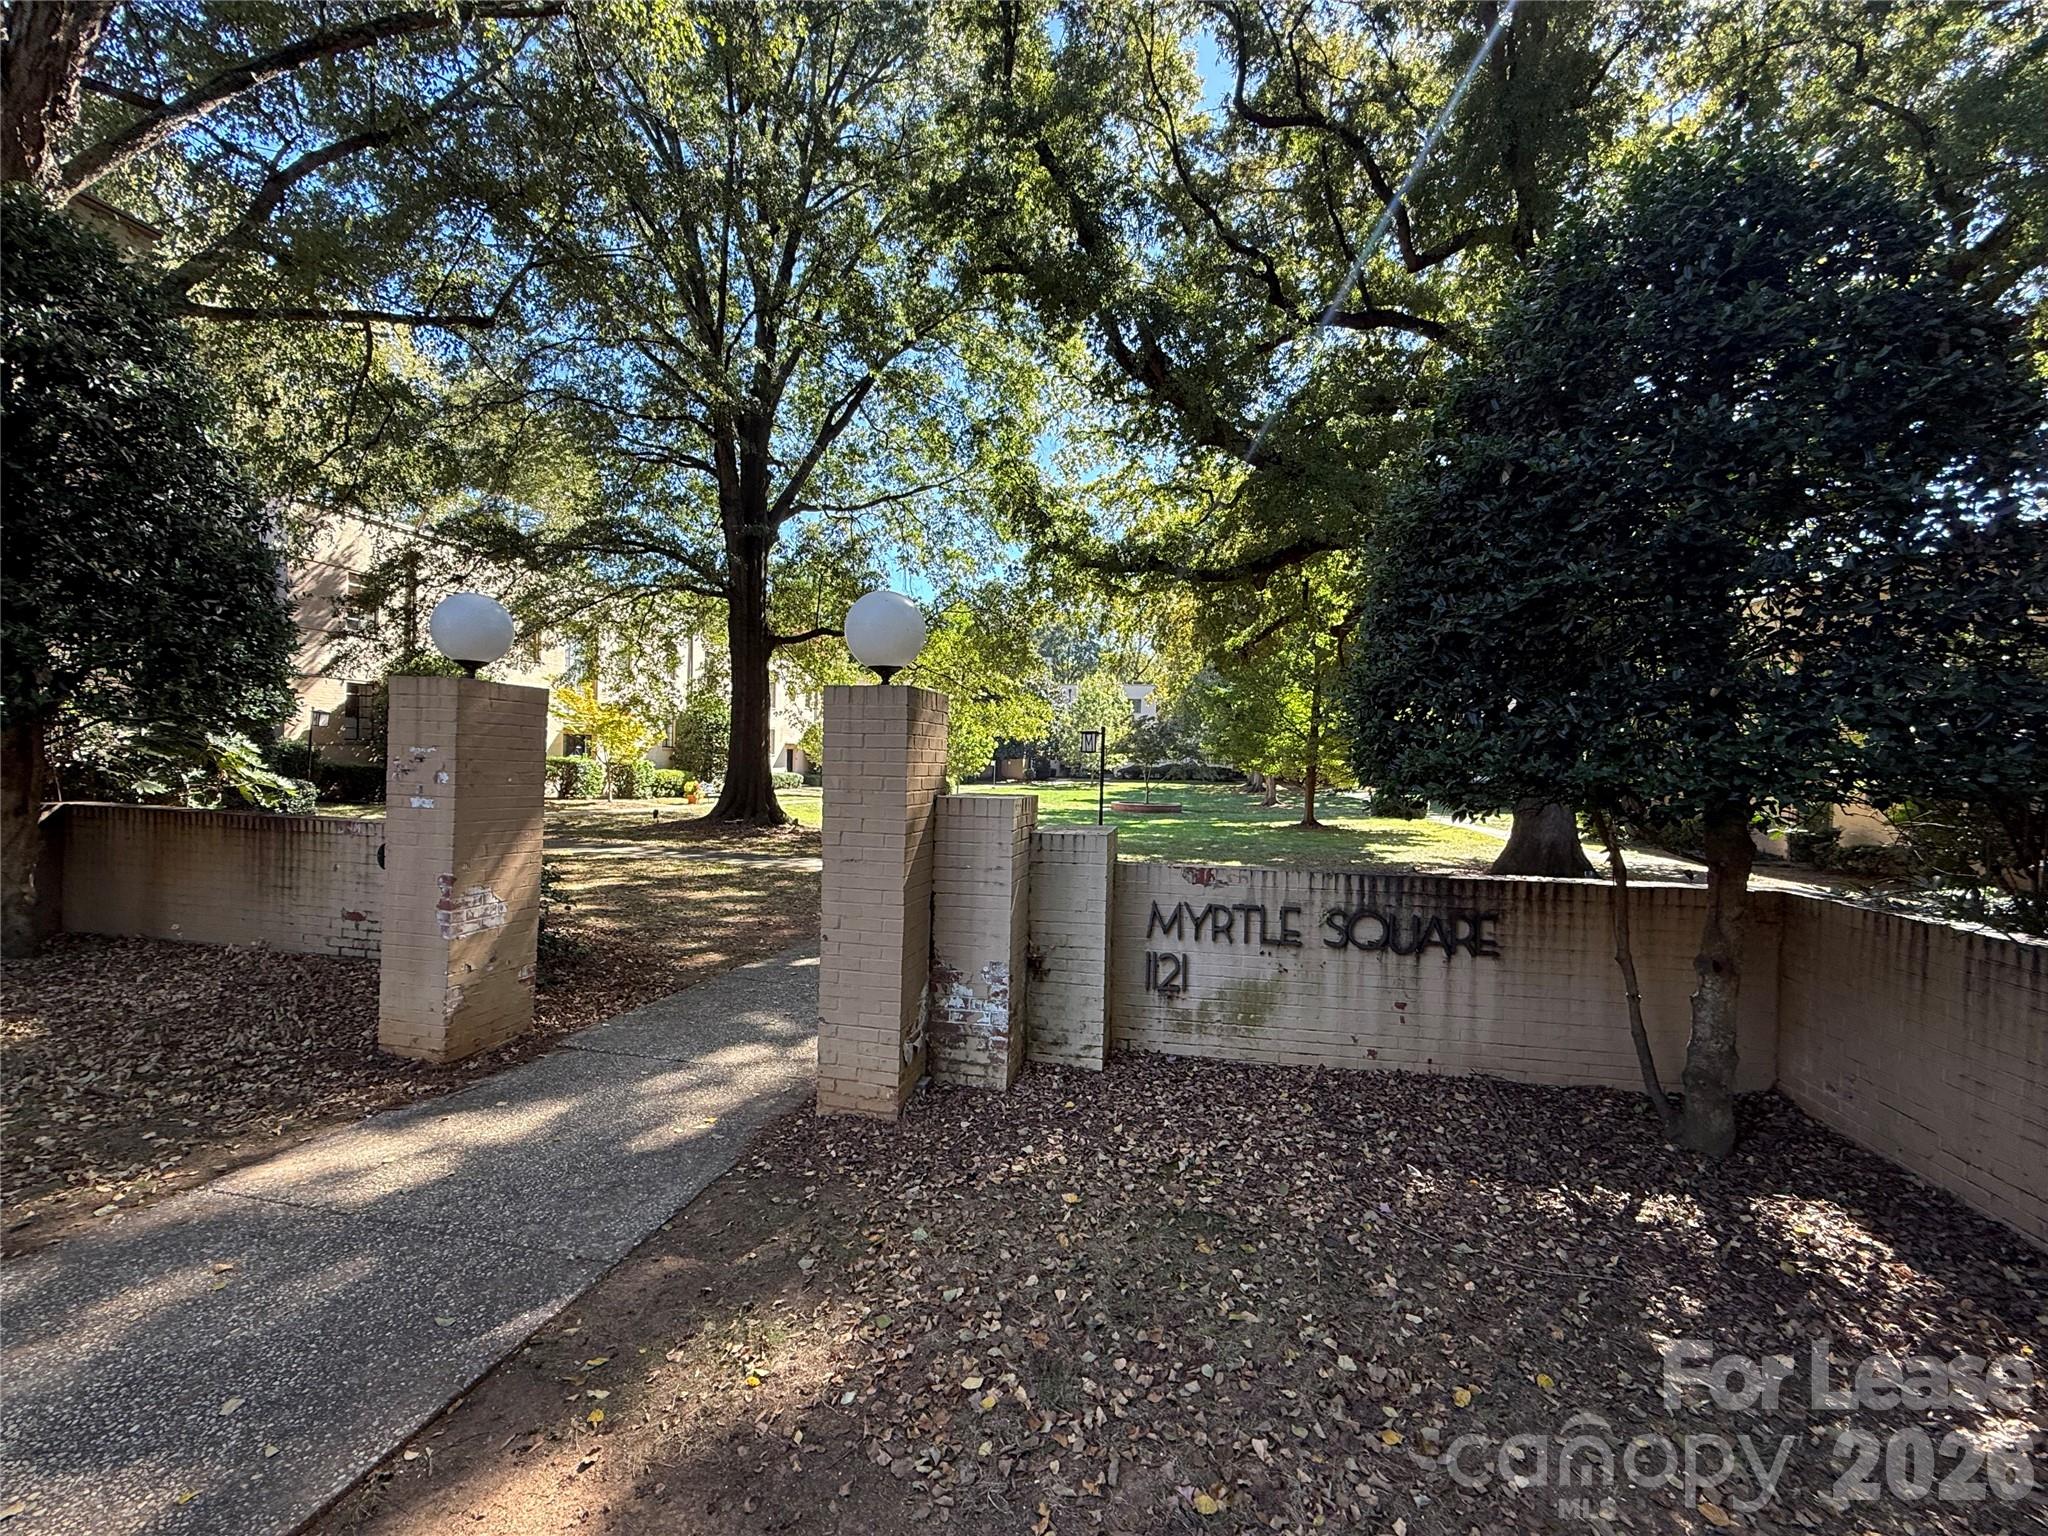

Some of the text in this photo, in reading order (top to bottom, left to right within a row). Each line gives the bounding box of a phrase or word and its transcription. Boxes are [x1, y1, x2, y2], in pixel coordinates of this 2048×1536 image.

[1146, 899, 1500, 957] MYRTLE SQUARE
[1145, 950, 1188, 993] 1121
